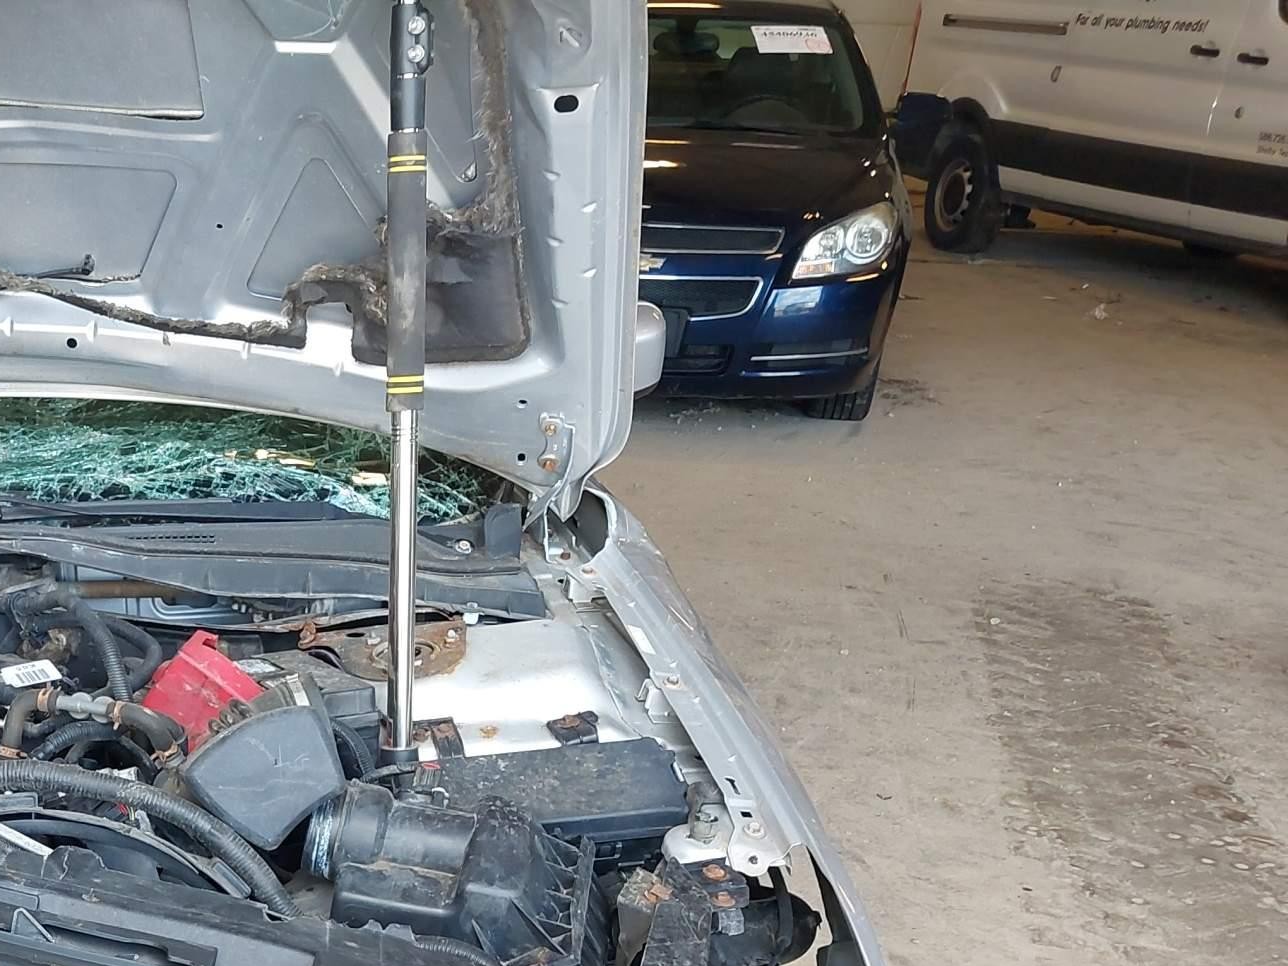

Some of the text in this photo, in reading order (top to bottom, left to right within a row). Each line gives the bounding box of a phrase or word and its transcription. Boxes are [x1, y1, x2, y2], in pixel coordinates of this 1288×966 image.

[1076, 12, 1210, 34] For all your plumbing needs!
